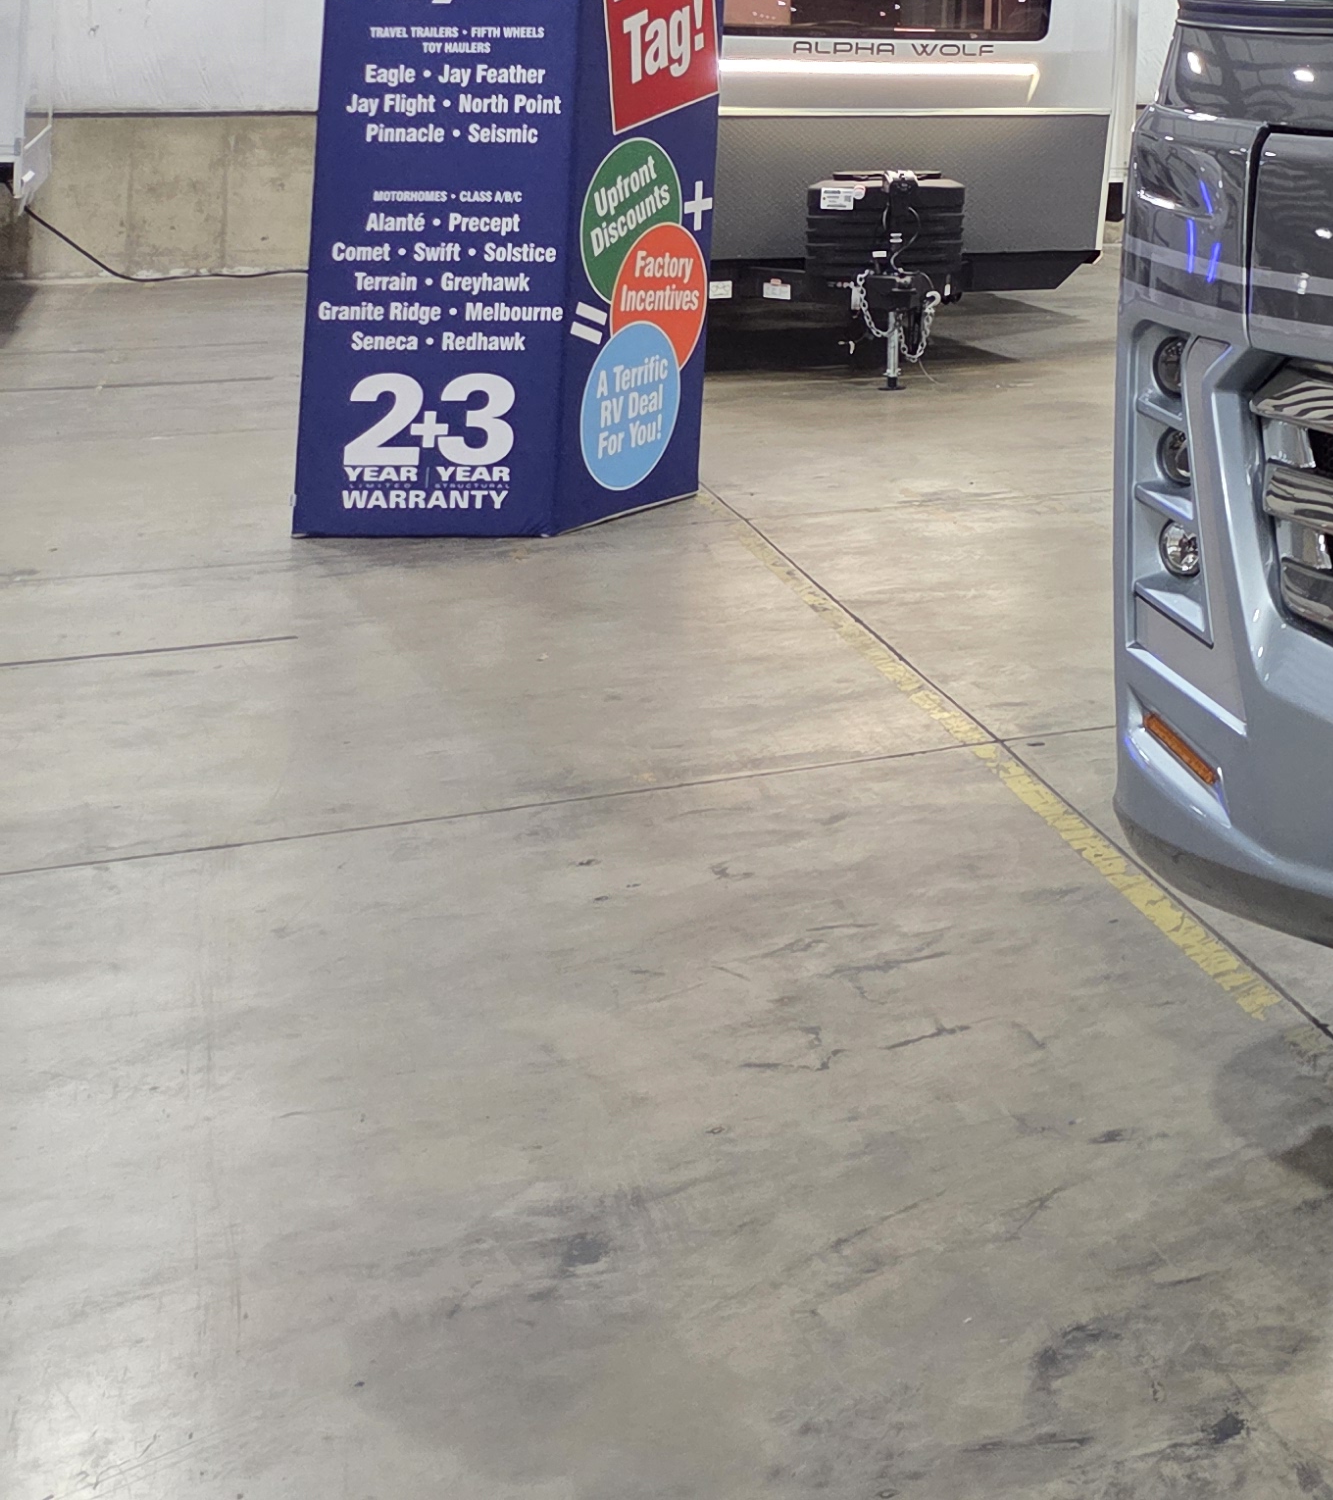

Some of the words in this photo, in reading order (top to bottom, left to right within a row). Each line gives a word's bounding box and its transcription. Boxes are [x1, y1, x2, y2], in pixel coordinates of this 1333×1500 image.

[370, 26, 408, 38] TRAVEL
[411, 26, 459, 38] TRAILERS
[470, 26, 501, 38] FIFTH
[503, 26, 545, 38] WHEELS
[422, 42, 442, 54] TOY
[444, 42, 491, 54] HAULERS
[793, 41, 895, 56] ALPHA
[911, 43, 994, 57] WOLF
[364, 63, 417, 88] Eagle
[437, 64, 472, 88] Jay
[475, 64, 546, 84] Feather
[345, 93, 380, 117] Jay
[383, 93, 437, 117] Flight
[458, 94, 509, 114] North
[513, 94, 562, 115] Point
[365, 123, 445, 143] Pinnacle
[467, 123, 539, 144] Seismic
[372, 190, 448, 203] MOTORHOMES
[458, 190, 493, 203] CLASS
[494, 190, 523, 203] A/B/C
[593, 155, 657, 218] Upfront
[365, 212, 426, 232] Alanté
[448, 212, 521, 237] Precept
[590, 184, 671, 258] Discounts
[331, 242, 391, 262] Comet
[413, 242, 462, 262] Swift
[483, 242, 557, 263] Solstice
[634, 250, 694, 283] Factory
[354, 272, 418, 291] Terrain
[440, 272, 531, 295] Greyhawk
[620, 284, 700, 312] Incentives
[317, 301, 384, 321] Granite
[389, 301, 442, 325] Ridge
[465, 302, 564, 322] Melbourne
[351, 331, 419, 351] Seneca
[441, 332, 526, 351] Redhawk
[596, 369, 609, 399] A
[613, 354, 669, 393] Terrific
[600, 396, 624, 428] RV
[628, 383, 664, 419] Deal
[597, 431, 625, 459] For
[629, 413, 663, 448] You!
[343, 466, 418, 481] YEAR
[435, 466, 511, 481] YEAR
[342, 490, 509, 509] WARRANTY
